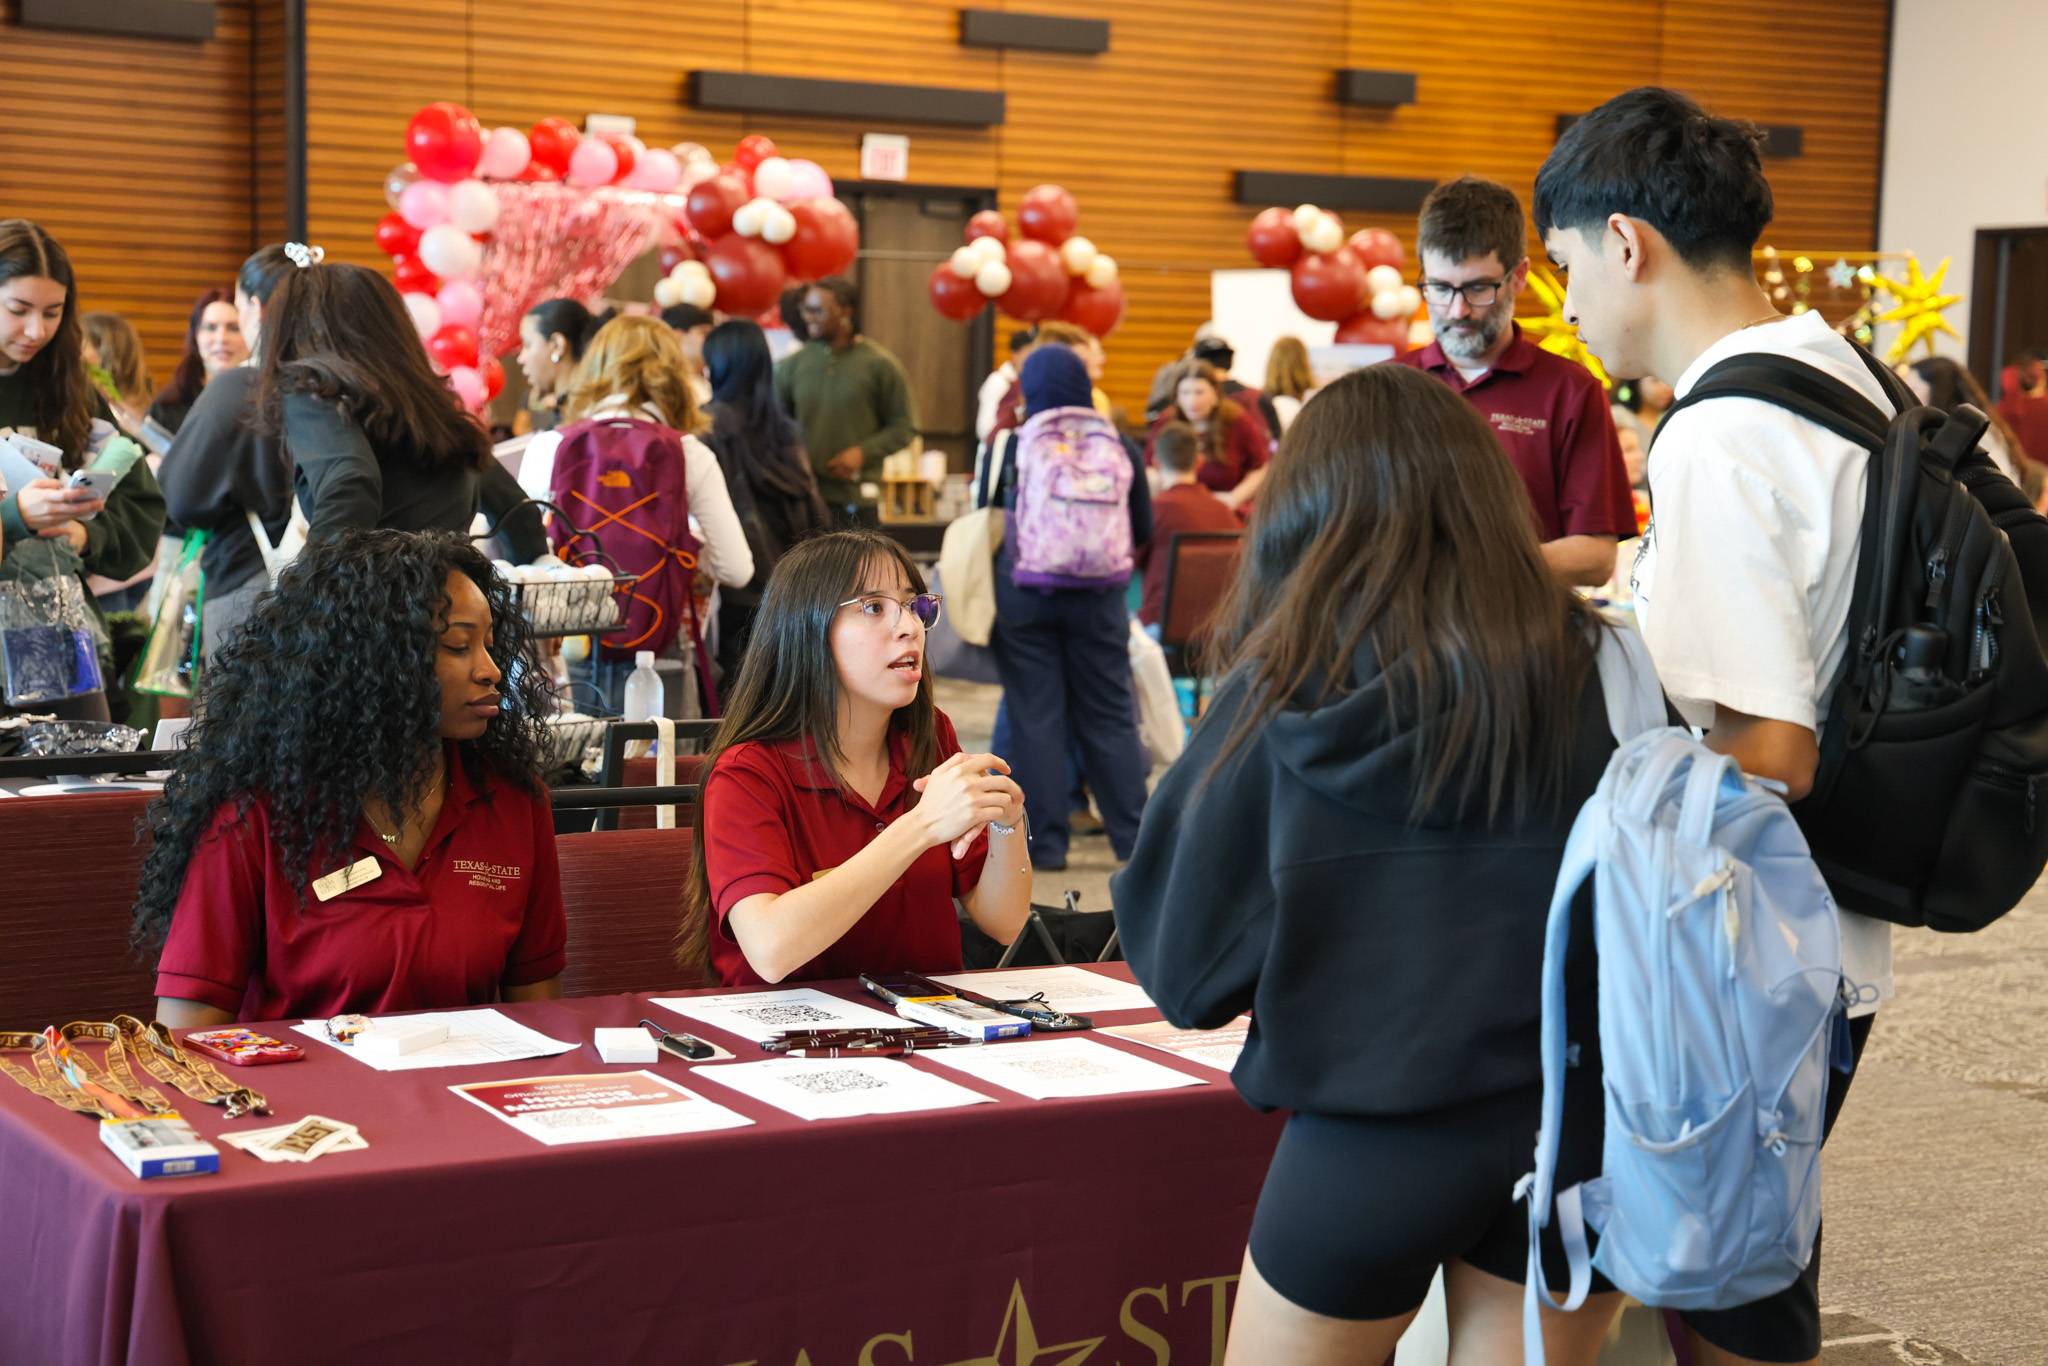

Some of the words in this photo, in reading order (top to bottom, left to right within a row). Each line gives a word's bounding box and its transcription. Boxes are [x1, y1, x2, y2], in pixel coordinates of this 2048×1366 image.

[453, 860, 485, 870] TEXAS
[491, 865, 520, 876] STATE
[503, 1092, 669, 1112] Marketplace
[522, 1090, 632, 1104] Housing
[269, 1119, 341, 1155] TXST
